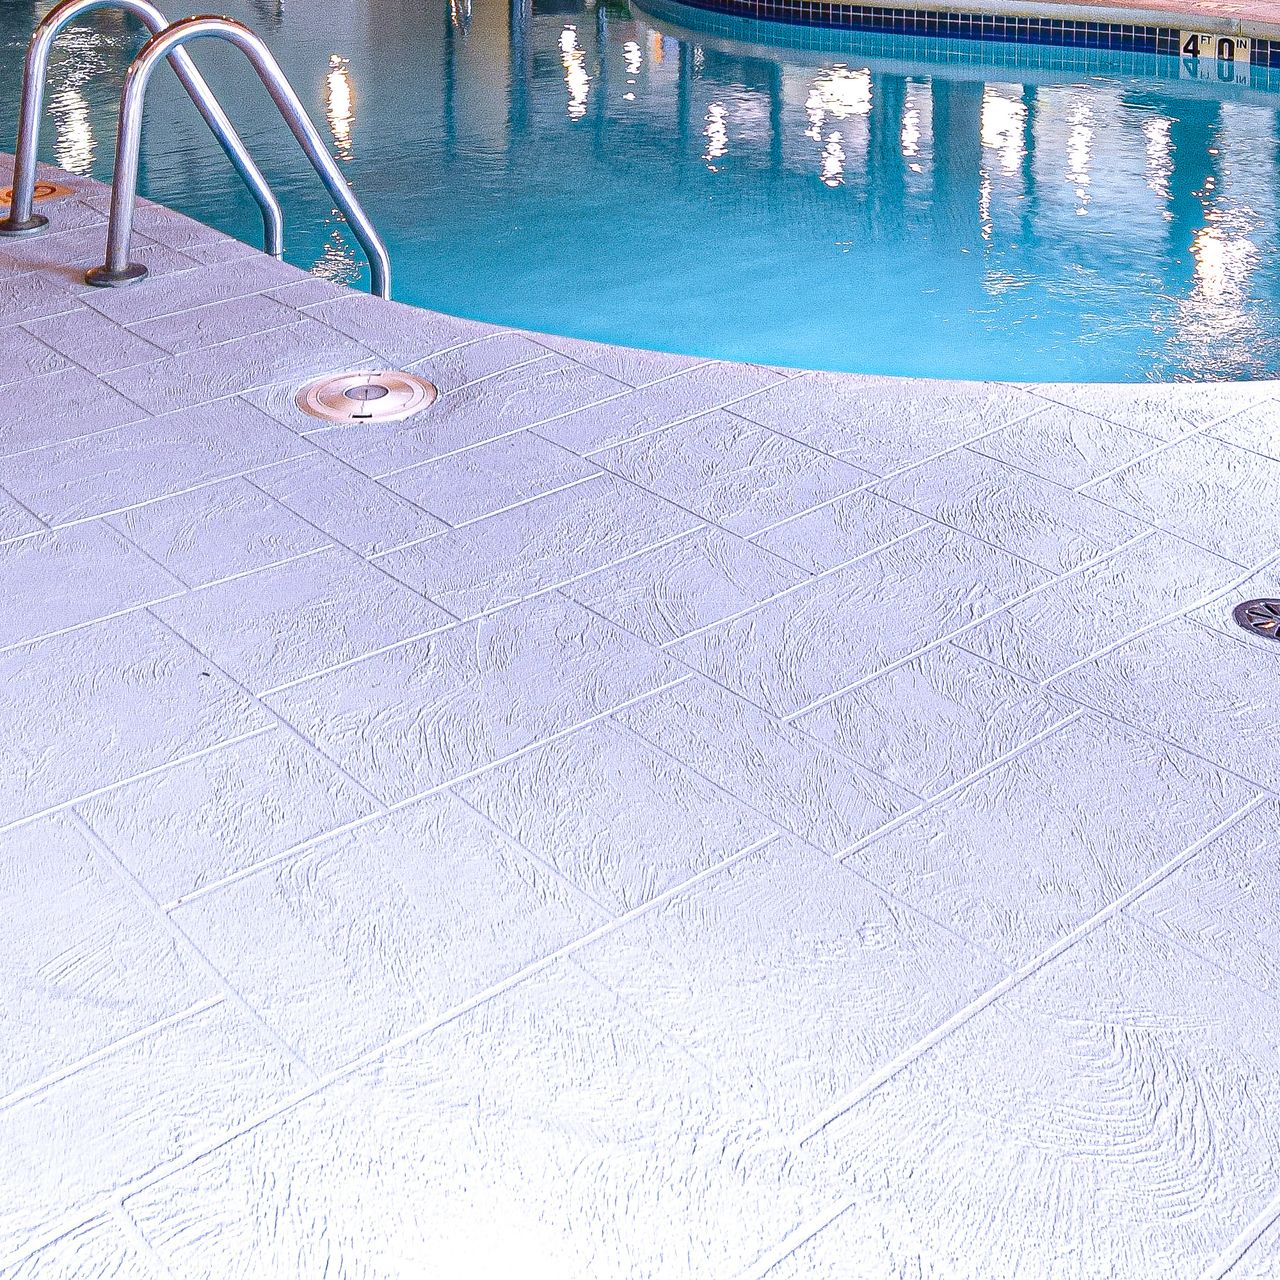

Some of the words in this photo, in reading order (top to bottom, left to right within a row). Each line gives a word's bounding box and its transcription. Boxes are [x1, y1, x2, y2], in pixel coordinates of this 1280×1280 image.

[1183, 34, 1200, 58] 4
[1201, 34, 1212, 45] FT
[1217, 37, 1235, 62] 0
[1236, 39, 1248, 50] IN
